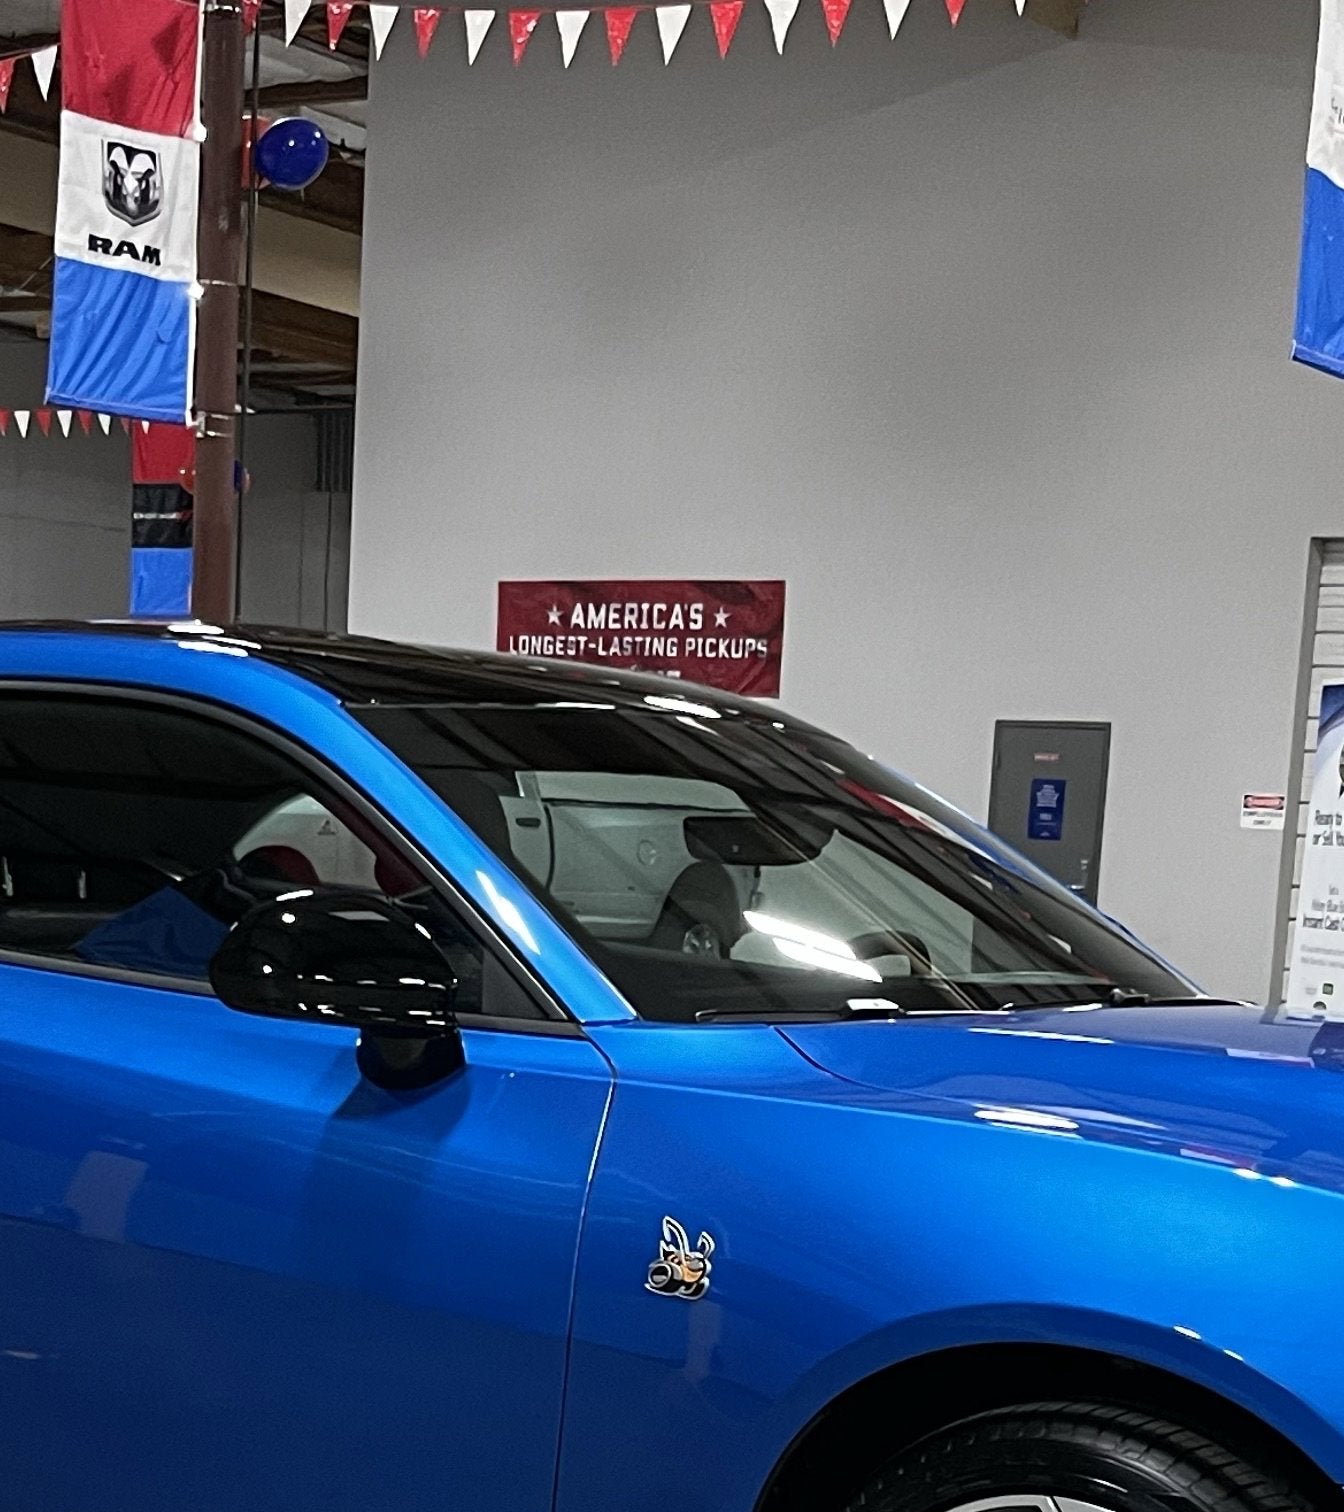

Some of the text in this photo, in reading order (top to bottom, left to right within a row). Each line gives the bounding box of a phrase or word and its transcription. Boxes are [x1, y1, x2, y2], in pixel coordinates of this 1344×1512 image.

[88, 233, 161, 267] RAM
[570, 602, 704, 630] AMERICA'S
[509, 634, 768, 659] LONGEST-LASTING PICKUPS
